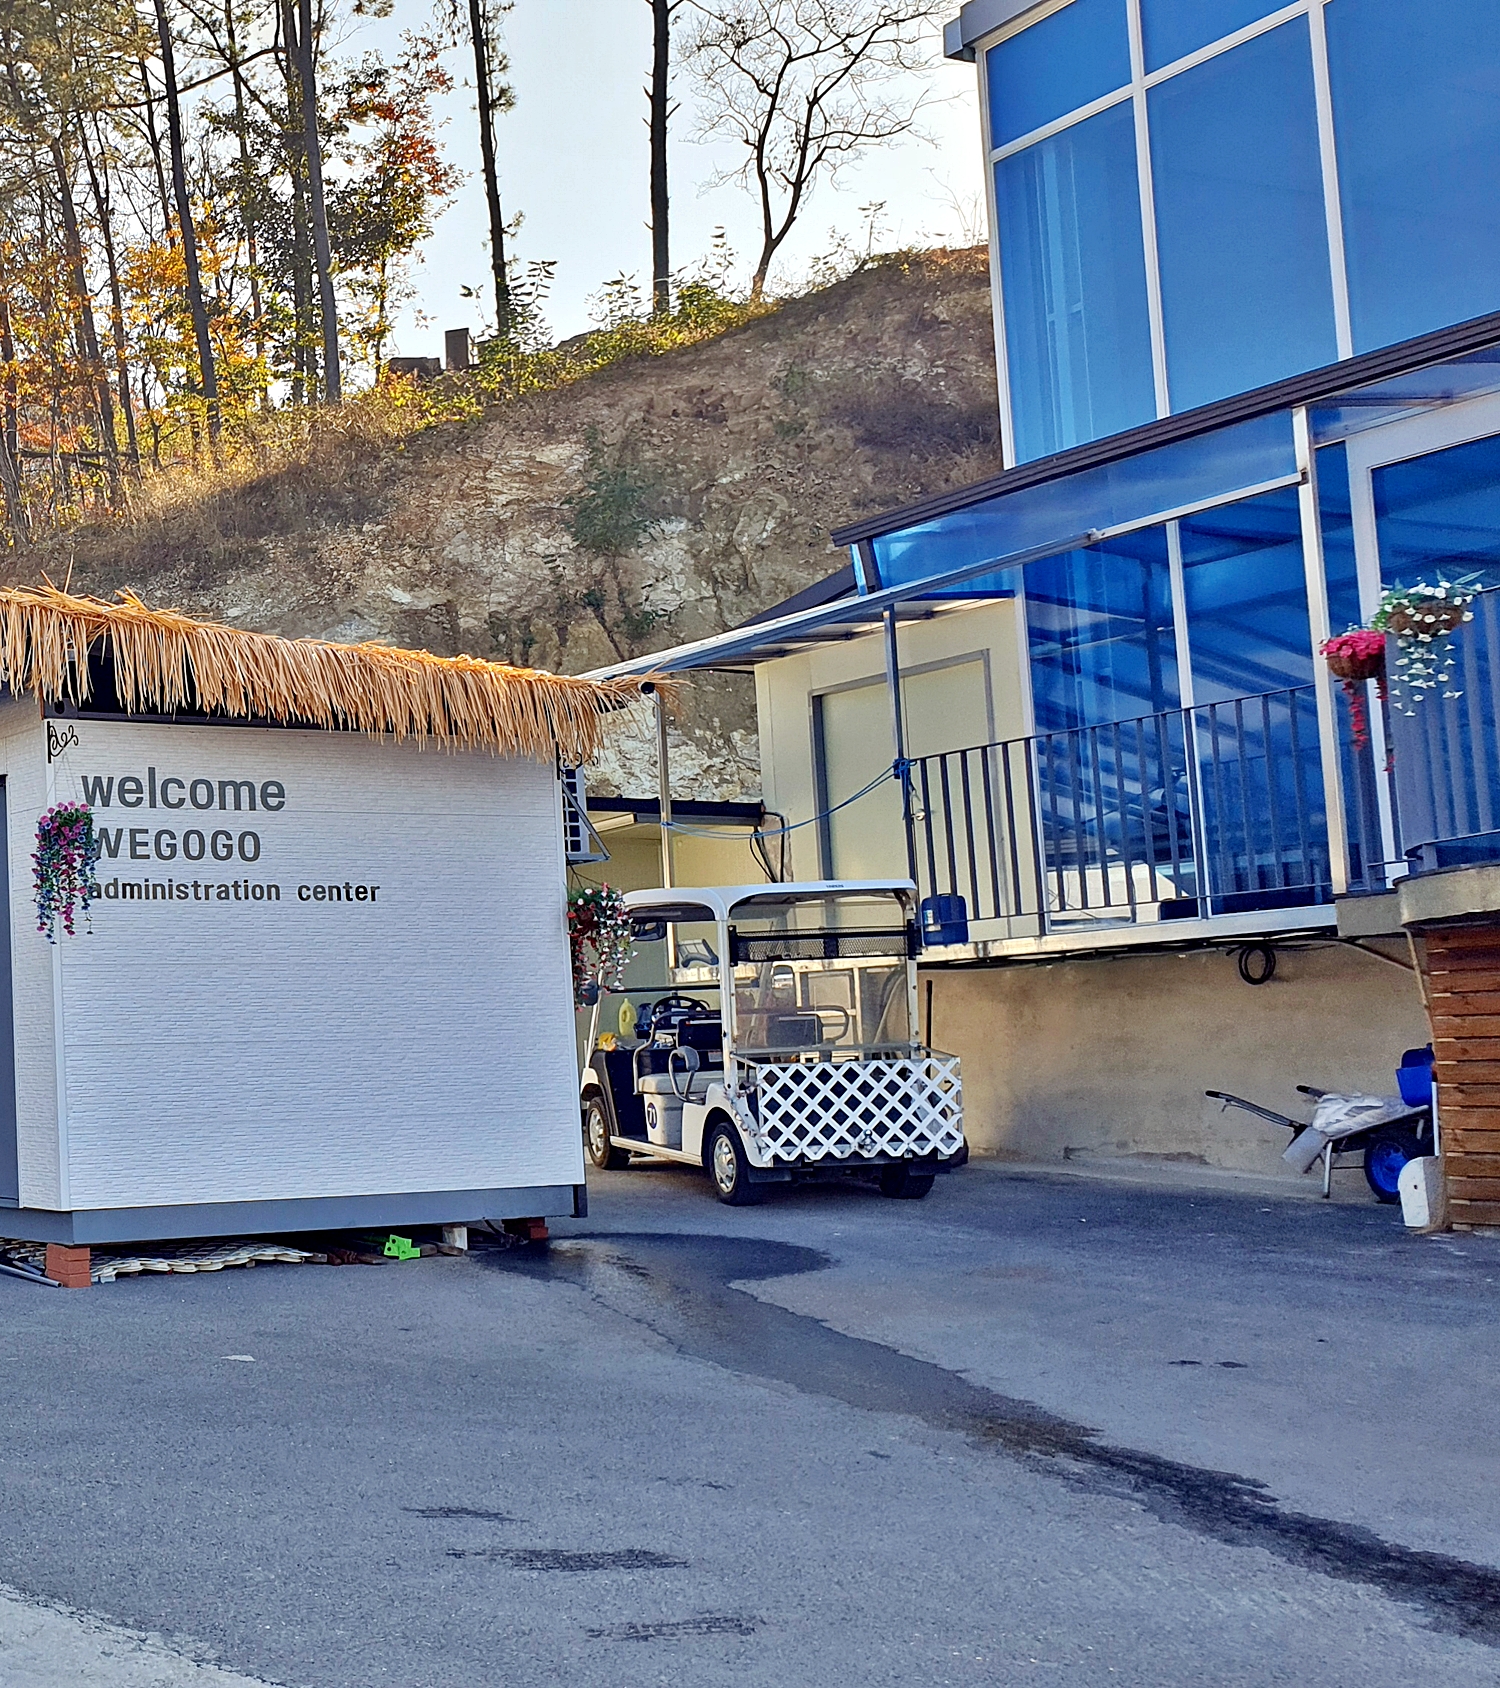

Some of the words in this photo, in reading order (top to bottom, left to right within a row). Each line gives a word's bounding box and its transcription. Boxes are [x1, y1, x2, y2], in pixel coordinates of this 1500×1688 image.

[81, 766, 286, 812] welcome
[93, 827, 262, 863] WEGOGO
[91, 877, 281, 902] administration
[297, 880, 381, 902] center
